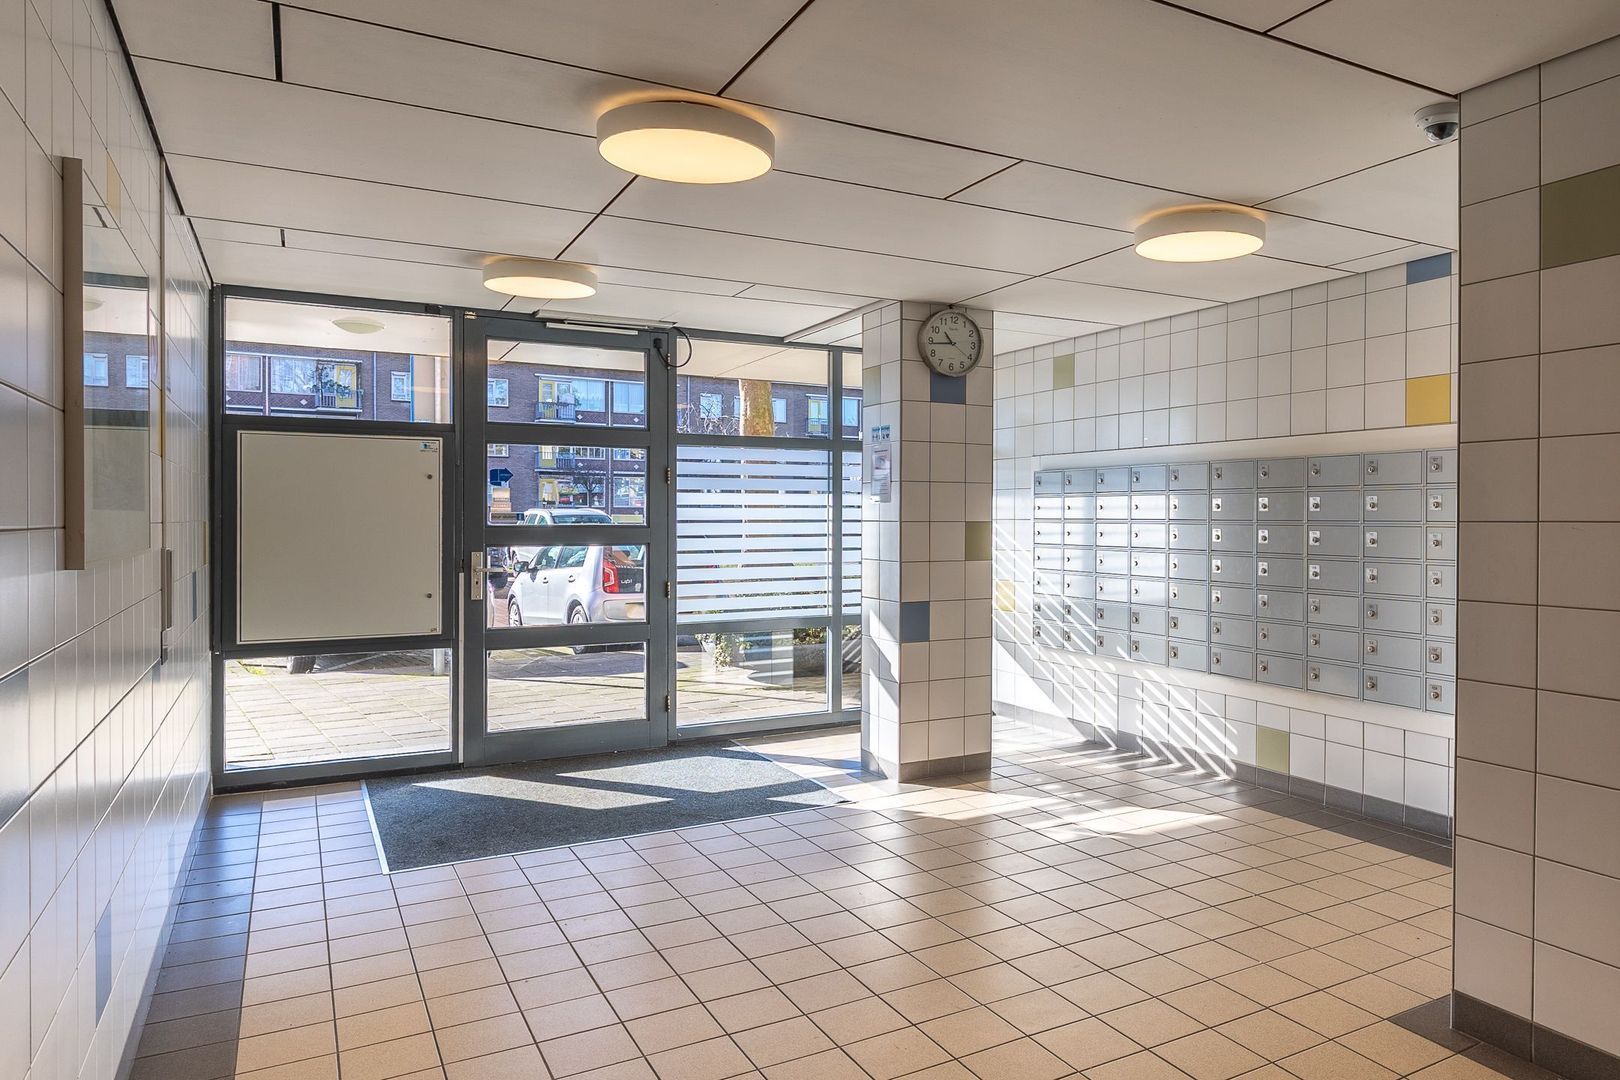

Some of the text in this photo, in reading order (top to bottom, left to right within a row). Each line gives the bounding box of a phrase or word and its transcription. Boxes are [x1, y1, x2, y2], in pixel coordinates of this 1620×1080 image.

[939, 317, 947, 325] 11
[950, 316, 959, 324] 12
[931, 326, 940, 334] 10
[968, 330, 974, 338] 2
[928, 336, 934, 345] 9
[970, 342, 976, 350] 3
[930, 349, 936, 357] 8
[967, 353, 972, 361] 4
[949, 363, 954, 371] 6
[959, 361, 965, 369] 5
